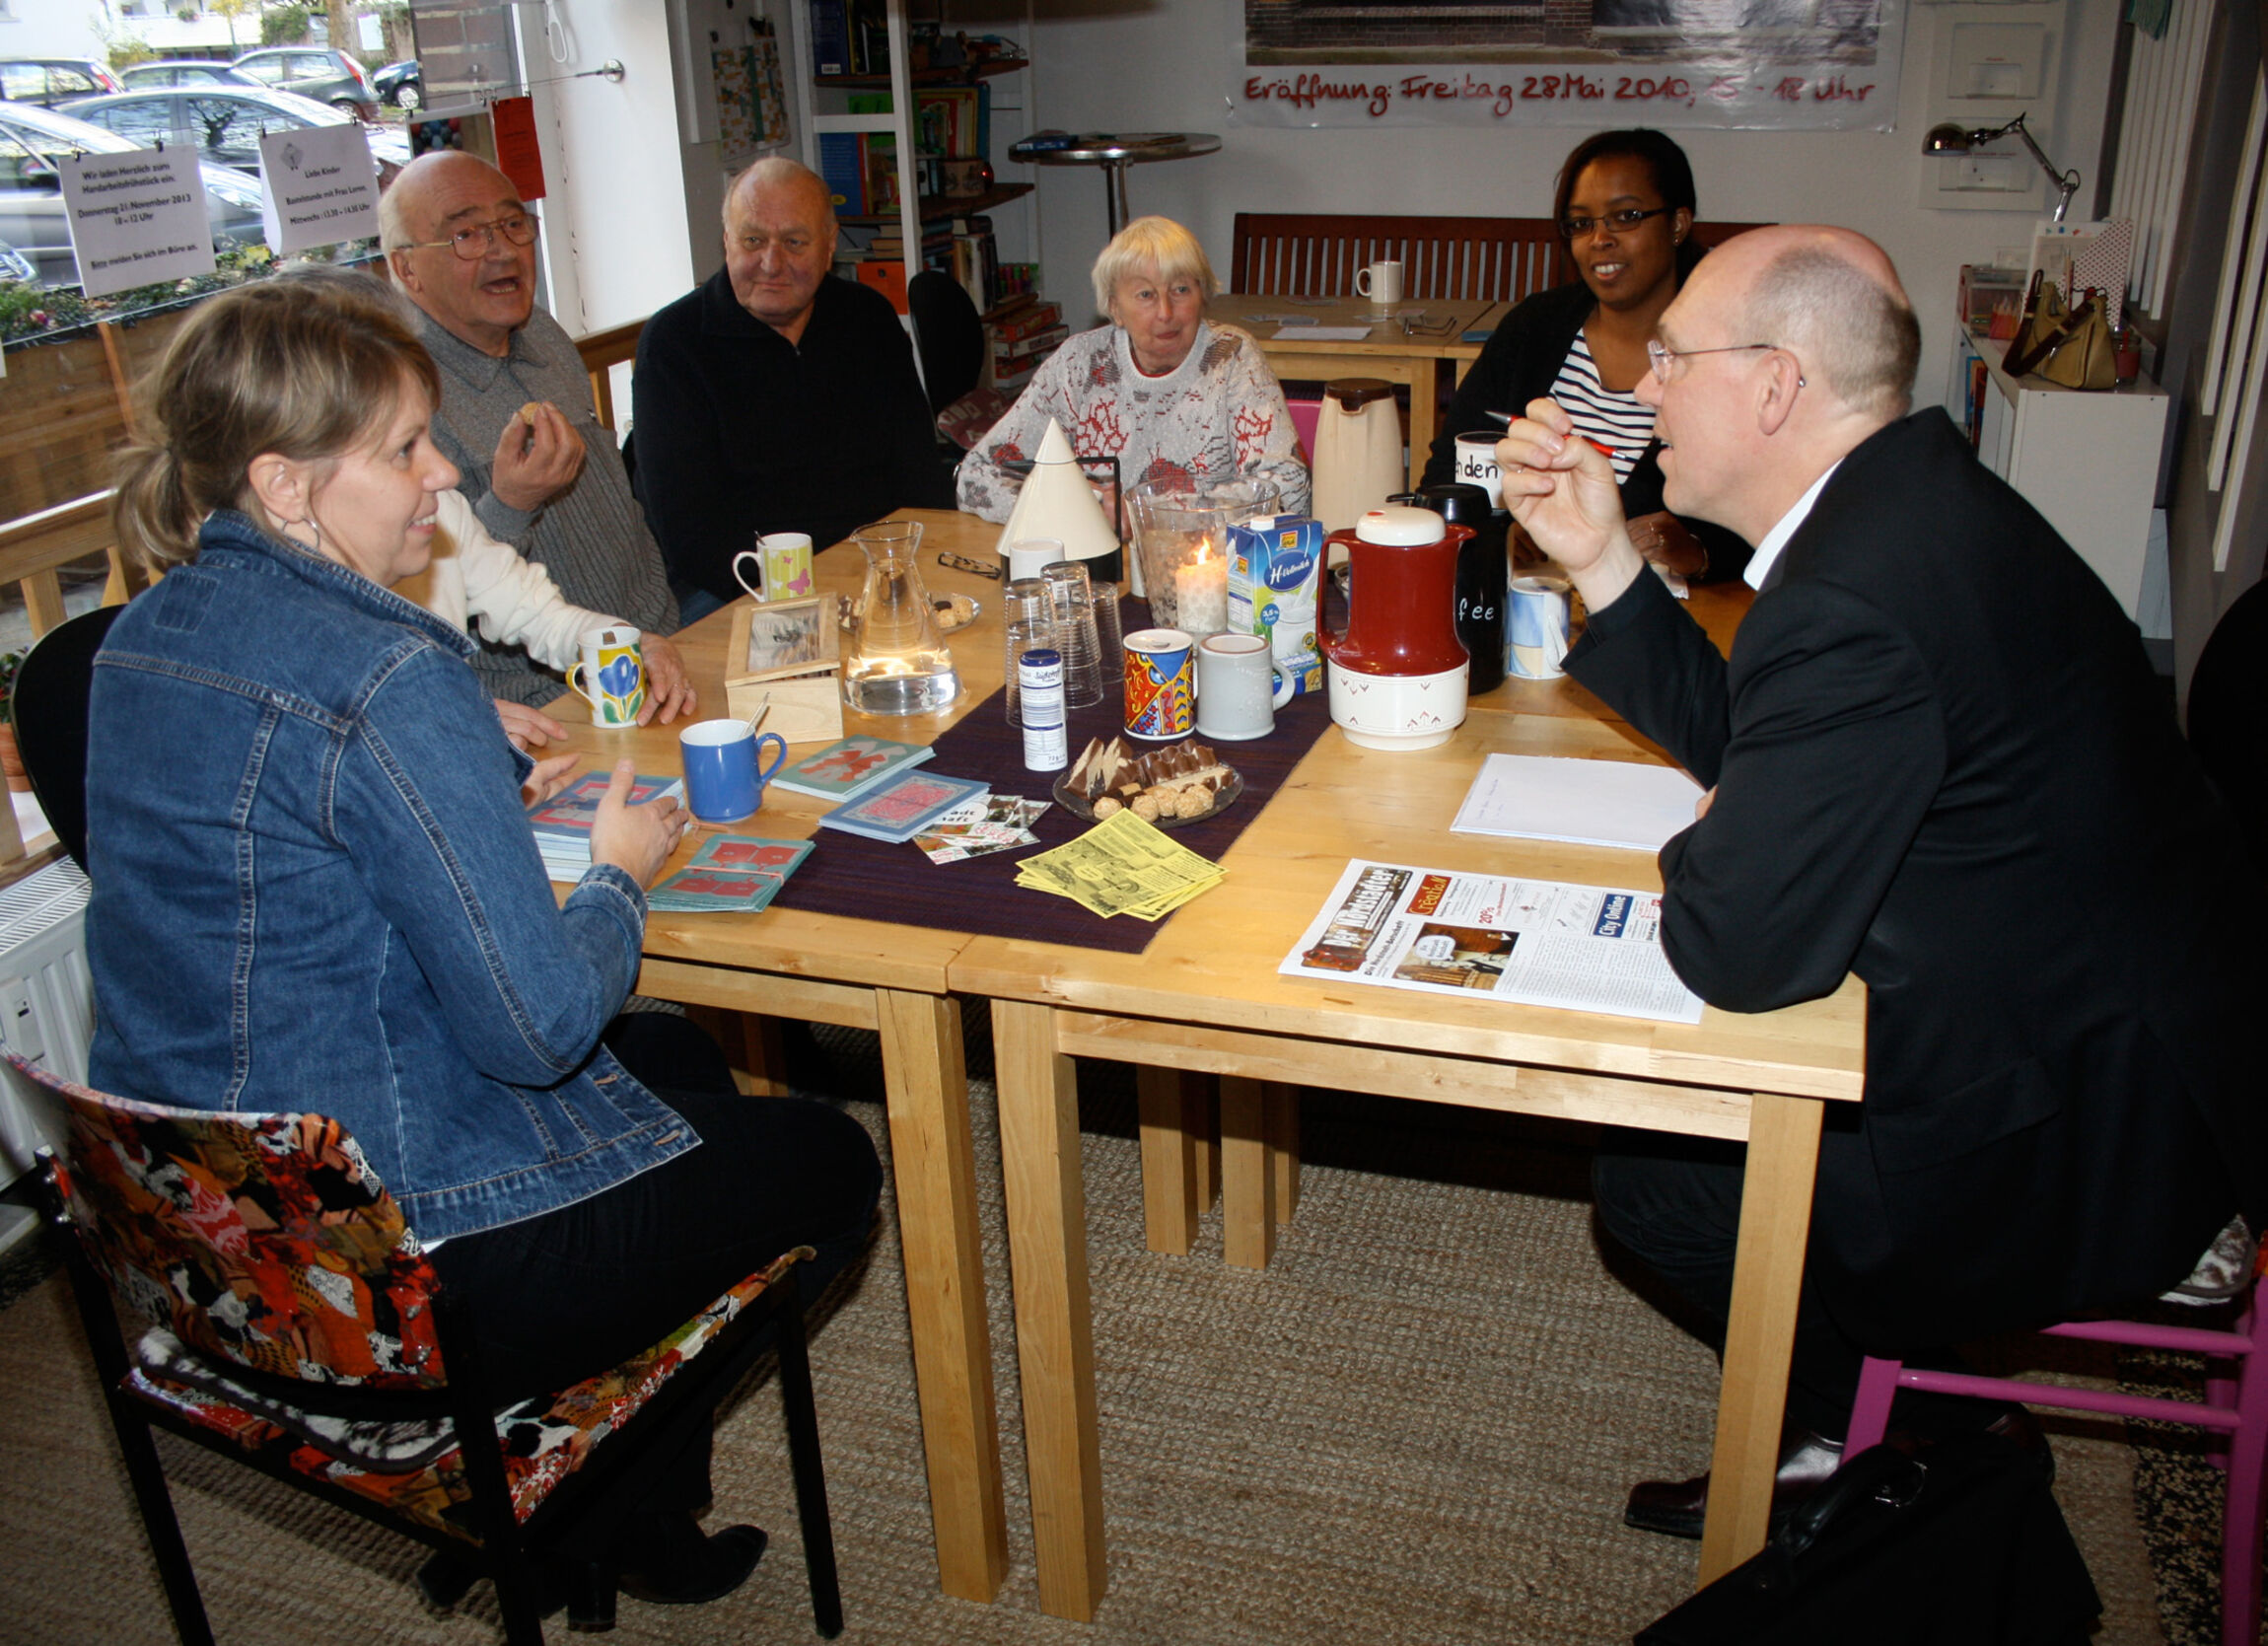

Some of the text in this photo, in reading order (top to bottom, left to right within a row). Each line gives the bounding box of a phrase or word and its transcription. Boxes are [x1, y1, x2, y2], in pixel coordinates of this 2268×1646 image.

[1244, 72, 1392, 117] Eröffnung:
[1400, 72, 1514, 117] Freitag
[1814, 74, 1877, 102] Uhr
[153, 163, 171, 172] zum
[172, 193, 191, 204] 2013
[139, 212, 154, 222] Uhr
[1335, 869, 1394, 928] Nordstädter
[1598, 895, 1626, 936] City Online
[1322, 928, 1361, 948] Der
